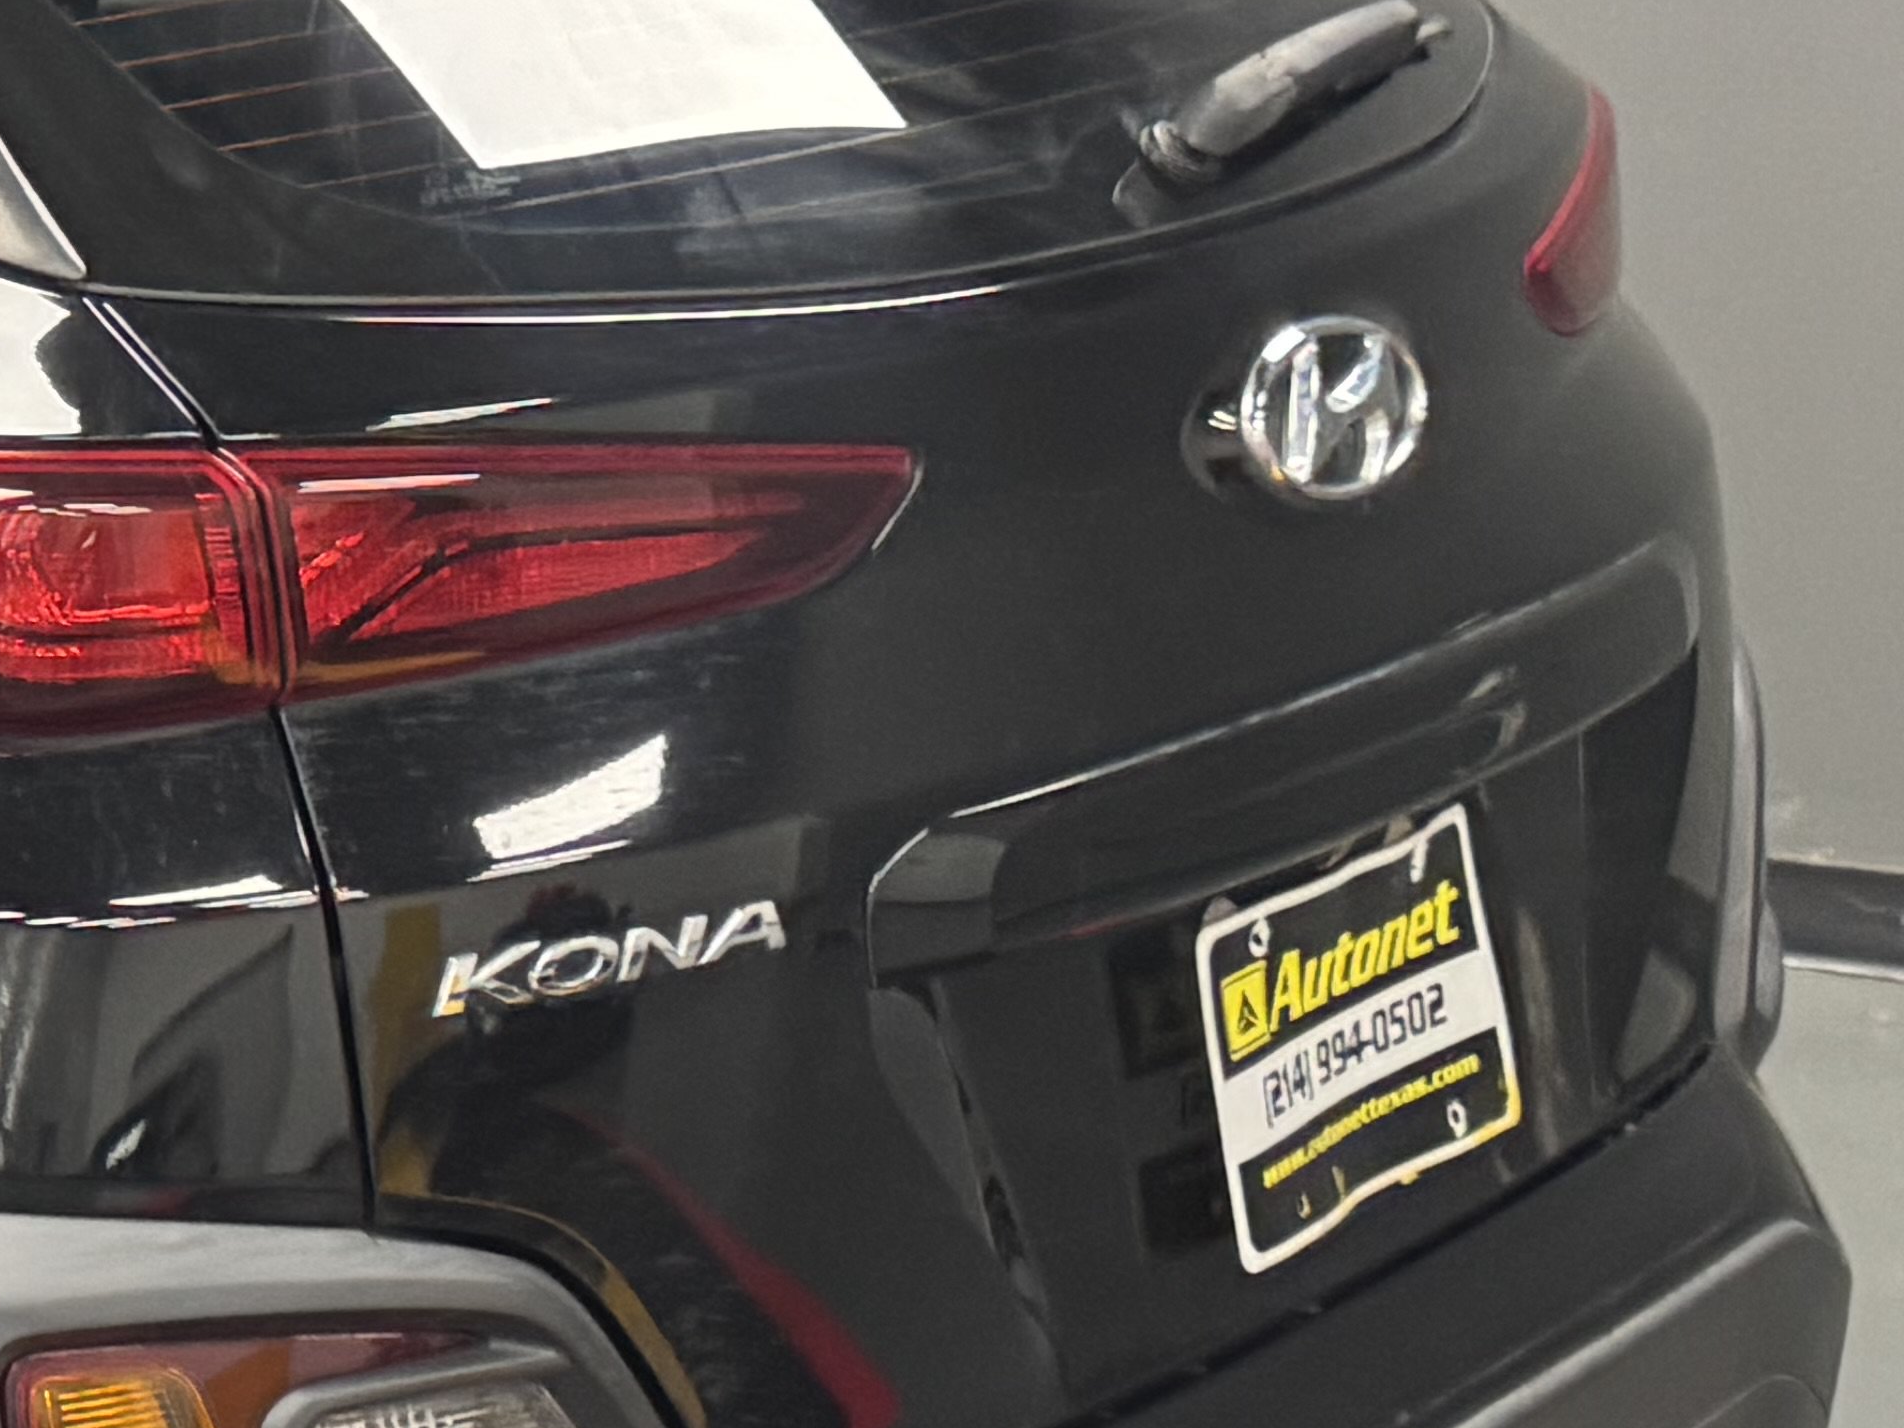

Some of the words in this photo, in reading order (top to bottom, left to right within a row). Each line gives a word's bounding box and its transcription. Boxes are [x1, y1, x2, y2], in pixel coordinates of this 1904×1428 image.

[432, 900, 786, 1017] KONA
[1269, 879, 1459, 1033] Autonet
[1262, 1049, 1314, 1129] (214)
[1316, 982, 1448, 1086] 994-0502
